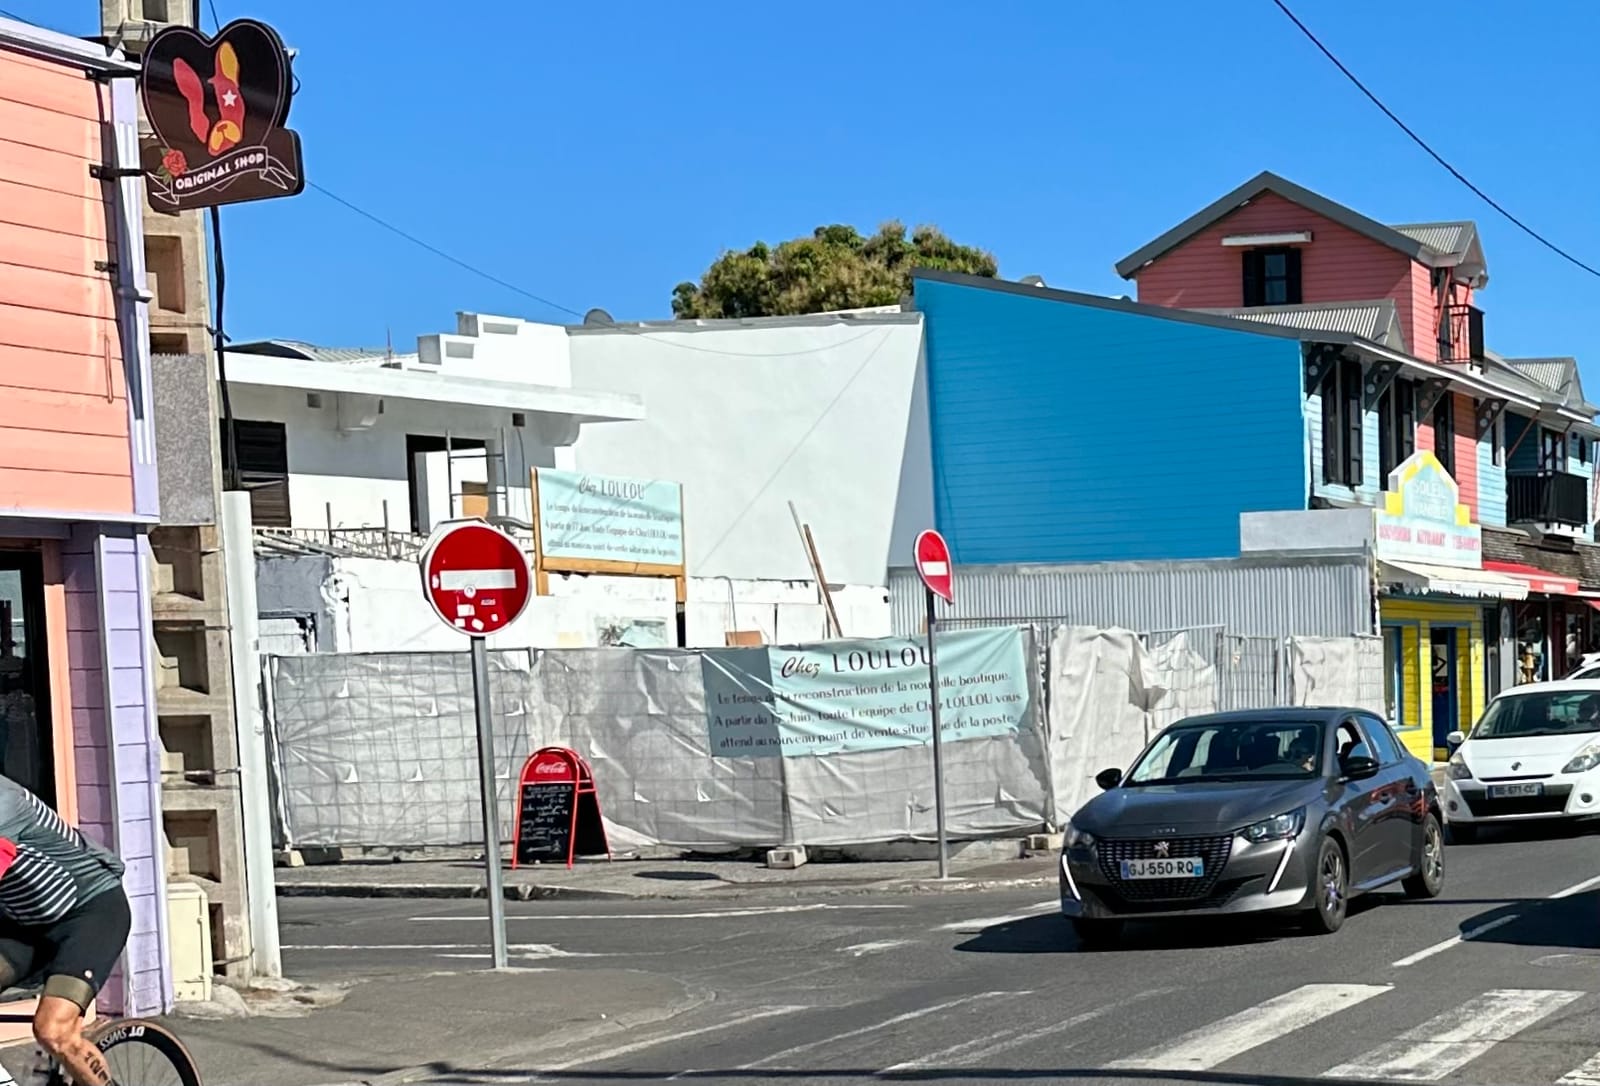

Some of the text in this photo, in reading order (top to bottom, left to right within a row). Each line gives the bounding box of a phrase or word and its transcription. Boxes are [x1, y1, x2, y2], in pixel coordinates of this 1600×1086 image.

[175, 152, 265, 190] ORIGINAL SHOP
[601, 479, 645, 500] LOULOU
[781, 646, 931, 679] Chez LOULOU
[717, 692, 729, 705] Le
[793, 685, 878, 700] reconstruction
[880, 681, 895, 694] de
[897, 680, 908, 692] la
[713, 715, 723, 728] A
[725, 714, 752, 728] partir
[754, 712, 768, 725] du
[817, 708, 849, 720] toute
[899, 702, 914, 714] de
[946, 692, 993, 709] LOULOU
[995, 693, 1021, 704] vous
[720, 735, 753, 748] attend
[755, 737, 767, 746] au
[768, 733, 816, 747] nouveau
[818, 730, 848, 745] point
[851, 727, 866, 740] de
[868, 726, 899, 738] vente
[953, 716, 968, 729] de
[969, 715, 980, 727] la
[100, 1025, 146, 1050] DT SWISS
